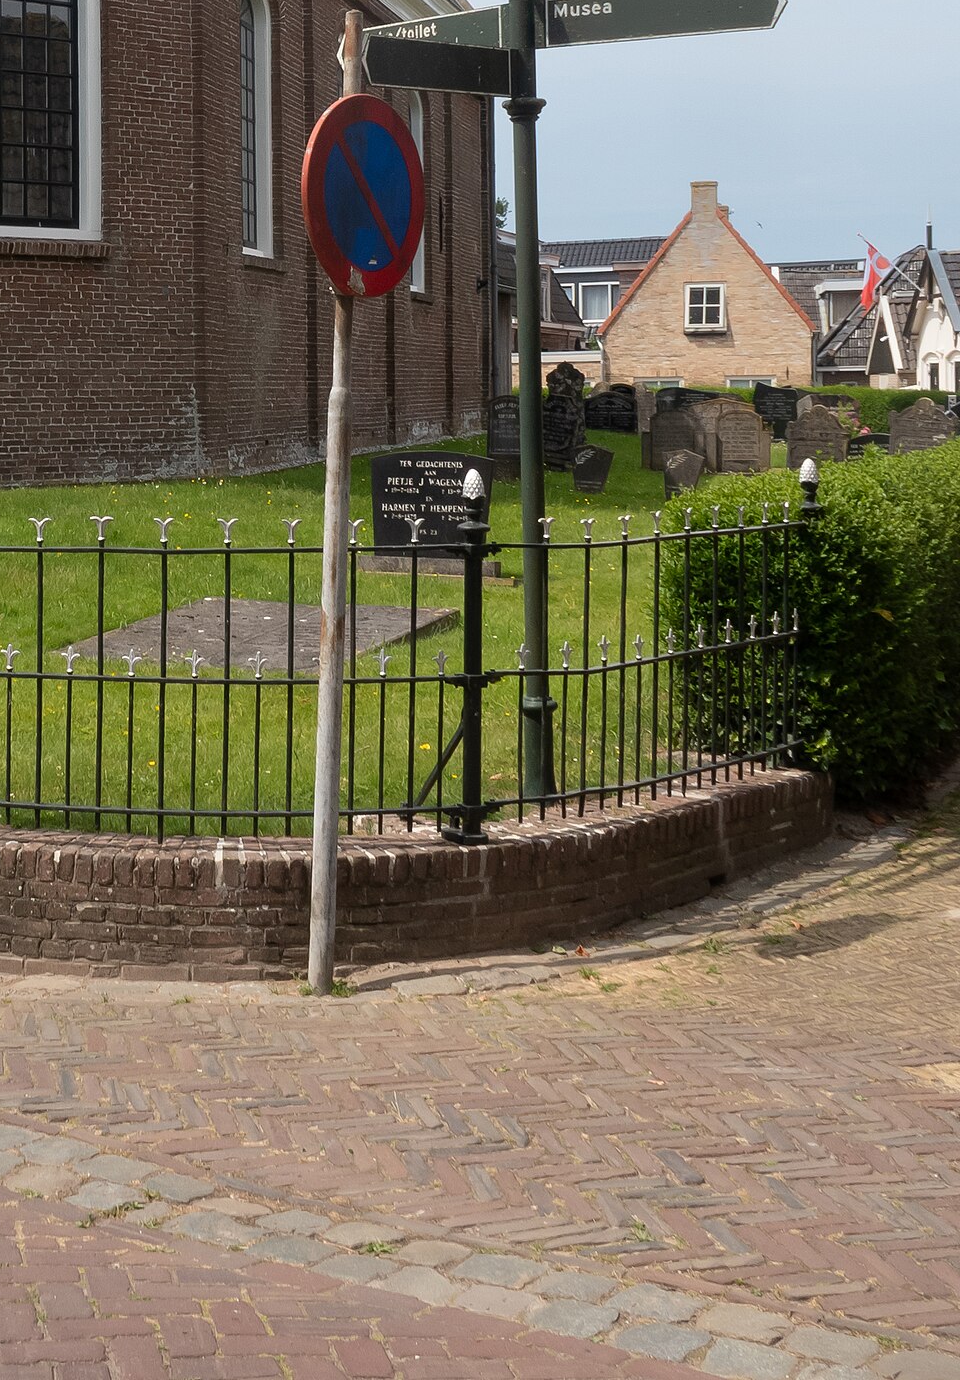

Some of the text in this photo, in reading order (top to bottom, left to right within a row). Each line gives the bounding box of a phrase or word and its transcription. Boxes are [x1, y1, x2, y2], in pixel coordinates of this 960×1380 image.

[553, 2, 612, 19] Musea
[400, 460, 412, 468] TER
[387, 477, 414, 486] PIETJE
[428, 478, 463, 487] WAGENA
[381, 503, 416, 512] HARMEN
